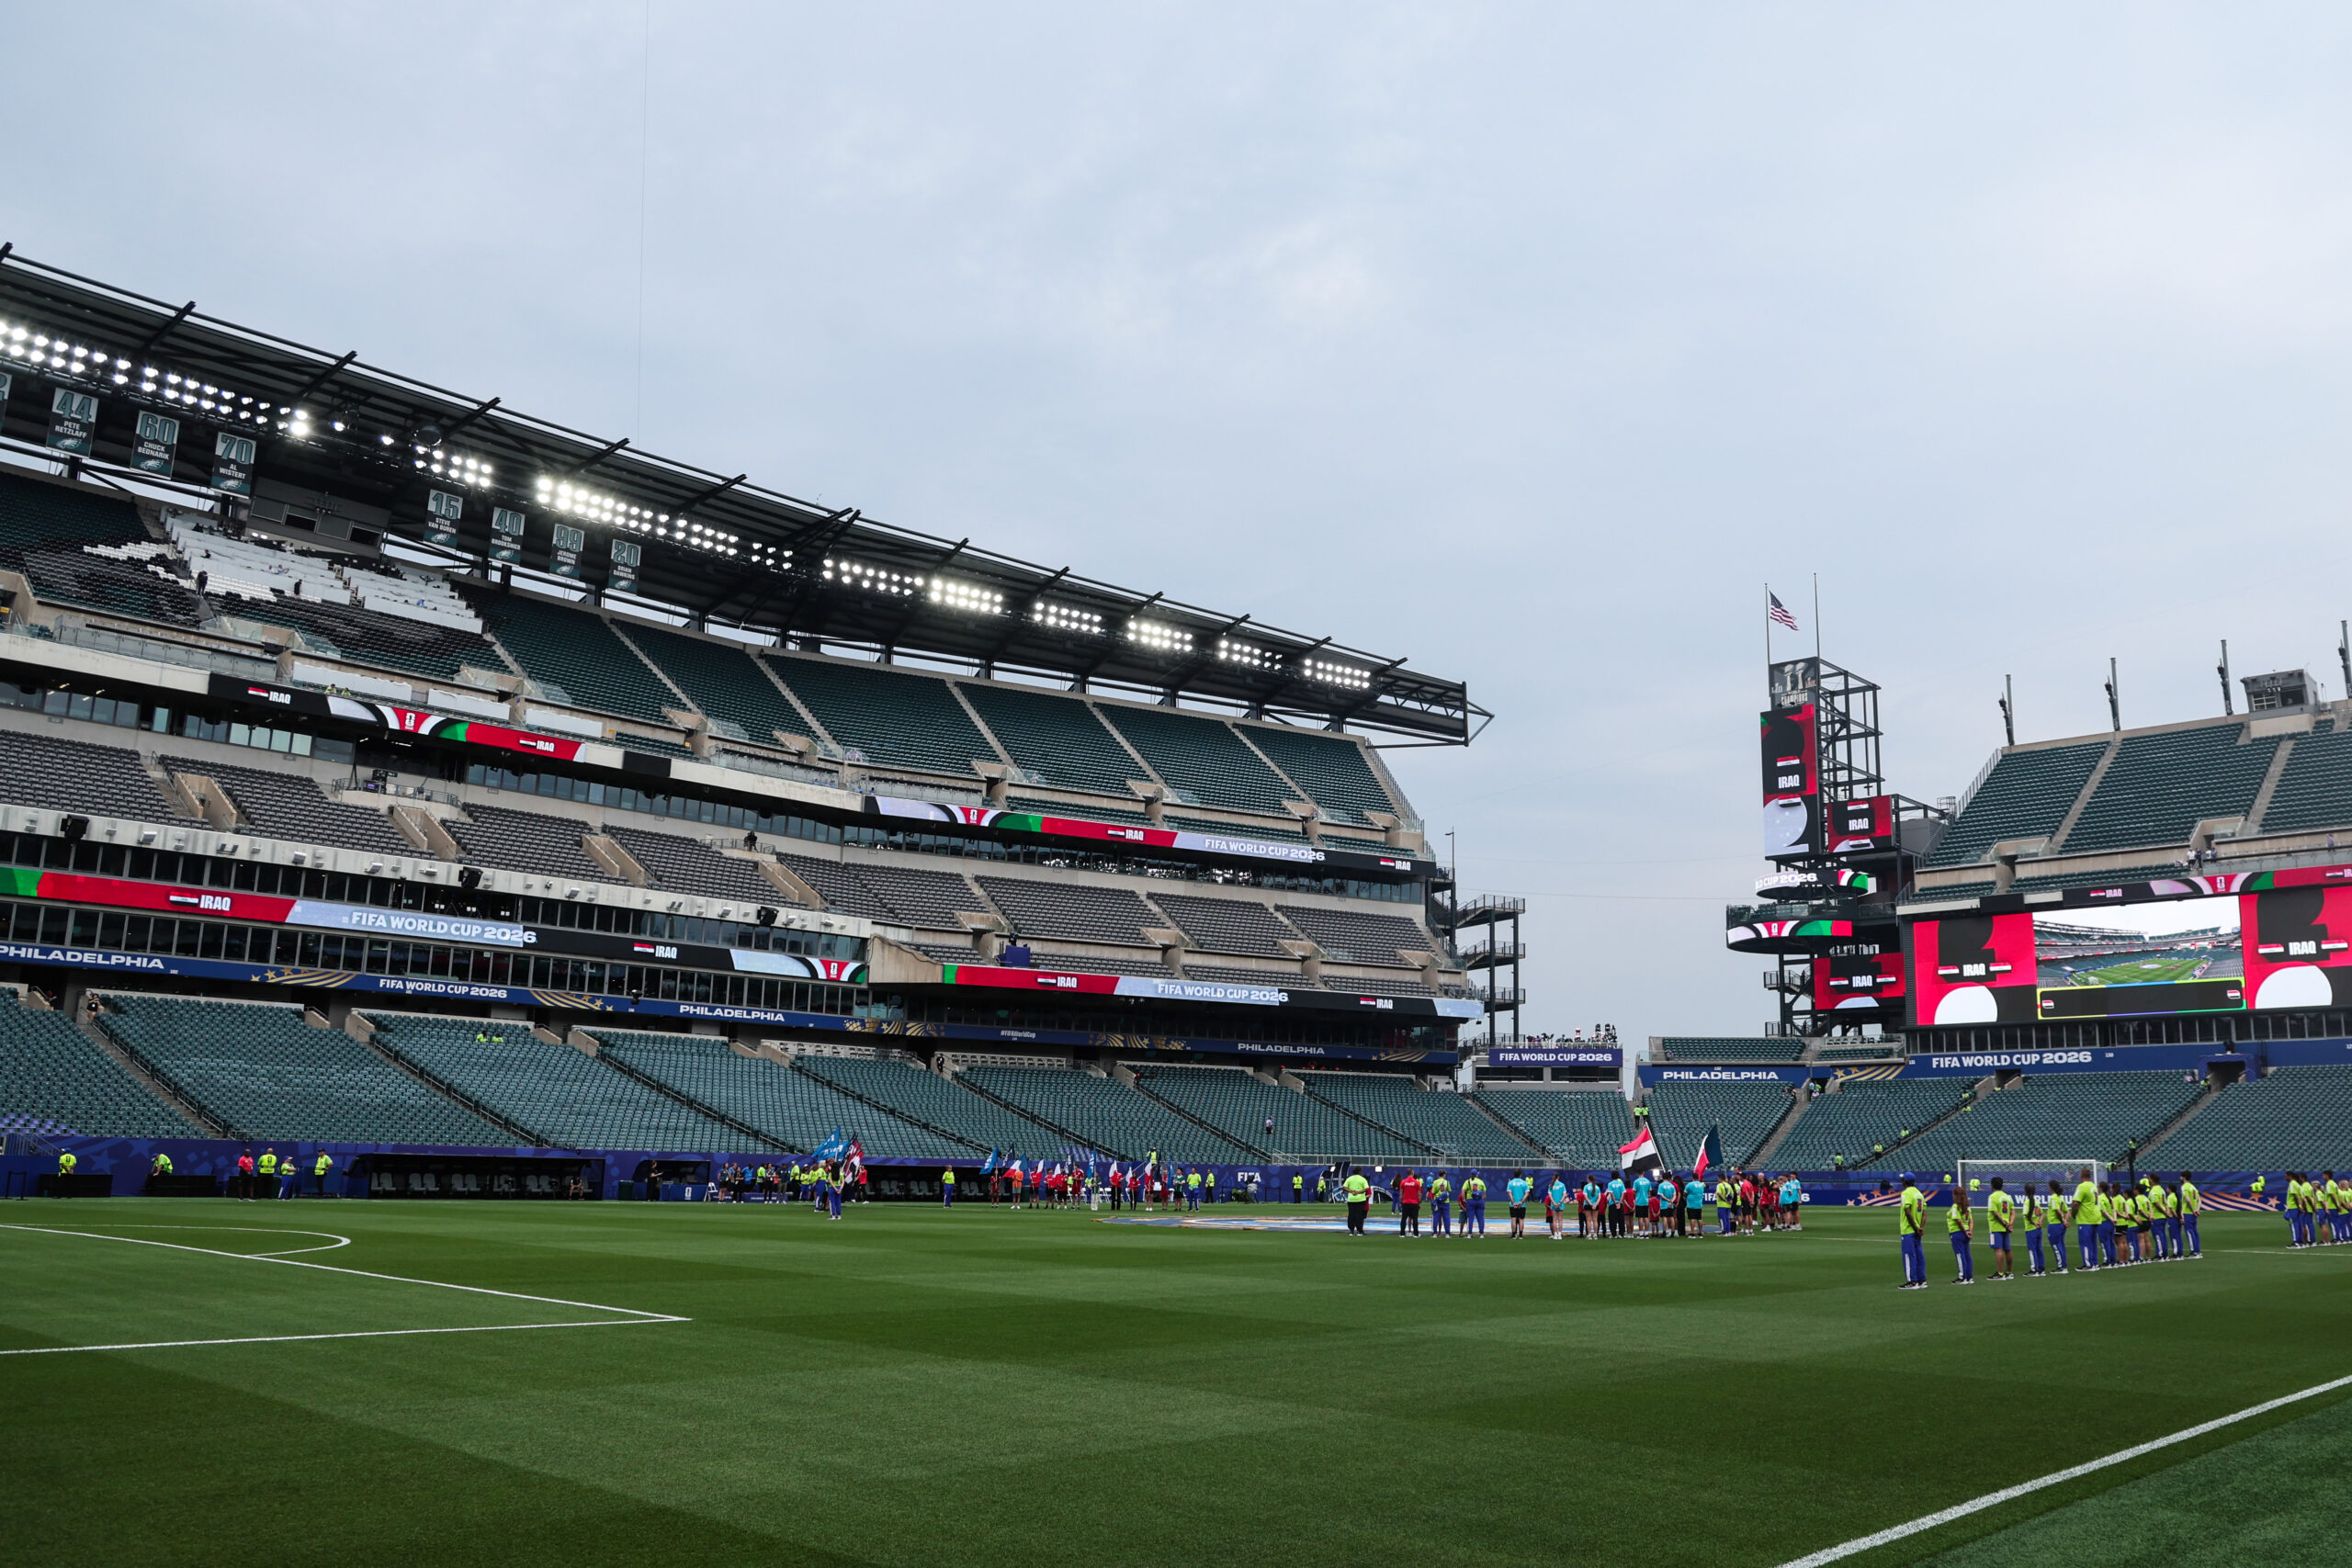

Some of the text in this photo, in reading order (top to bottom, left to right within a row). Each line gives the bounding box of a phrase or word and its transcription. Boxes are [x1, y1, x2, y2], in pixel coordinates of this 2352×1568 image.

[56, 391, 93, 423] 44
[55, 425, 87, 439] RETZLAFF
[63, 421, 81, 431] PETE
[140, 413, 176, 445] 60
[138, 446, 169, 460] BEDNARIK
[143, 441, 165, 452] CHUCK
[221, 434, 254, 465] 70
[220, 467, 246, 479] WISTERT
[432, 492, 459, 520] 15
[428, 522, 438, 530] VAN
[435, 517, 450, 526] STEVE
[495, 509, 522, 536] 40
[556, 525, 582, 553] 99
[613, 540, 639, 567] 20
[268, 691, 291, 705] IRAQ
[537, 739, 555, 752] IRAQ
[1778, 774, 1800, 789] IRAQ
[1849, 818, 1869, 830] IRAQ
[1125, 829, 1144, 840] IRAQ
[1204, 839, 1326, 861] FIFA WORLD CUP 2026
[1395, 861, 1411, 871] IRAQ
[1780, 873, 1817, 884] 2026
[2106, 888, 2123, 897] IRAQ
[199, 894, 232, 911] IRAQ
[351, 911, 537, 943] FIFA WORLD CUP 2026
[655, 945, 677, 960] IRAQ
[2288, 941, 2317, 955] IRAQ
[0, 944, 164, 969] PHILADELPHIA
[1962, 964, 1986, 976] IRAQ
[379, 978, 507, 998] FIFA WORLD CUP 2026
[1057, 976, 1078, 988] IRAQ
[1852, 976, 1873, 987] IRAQ
[1158, 983, 1288, 1002] FIFA WORLD CUP 2026
[1376, 998, 1394, 1010] IRAQ
[679, 1005, 786, 1021] PHILADELPHIA
[1238, 1043, 1325, 1055] PHILADELPHIA
[1499, 1053, 1612, 1062] FIFA WORLD CUP 2026
[1932, 1051, 2092, 1068] FIFA WORLD CUP 2026
[1663, 1071, 1780, 1080] PHILADELPHIA
